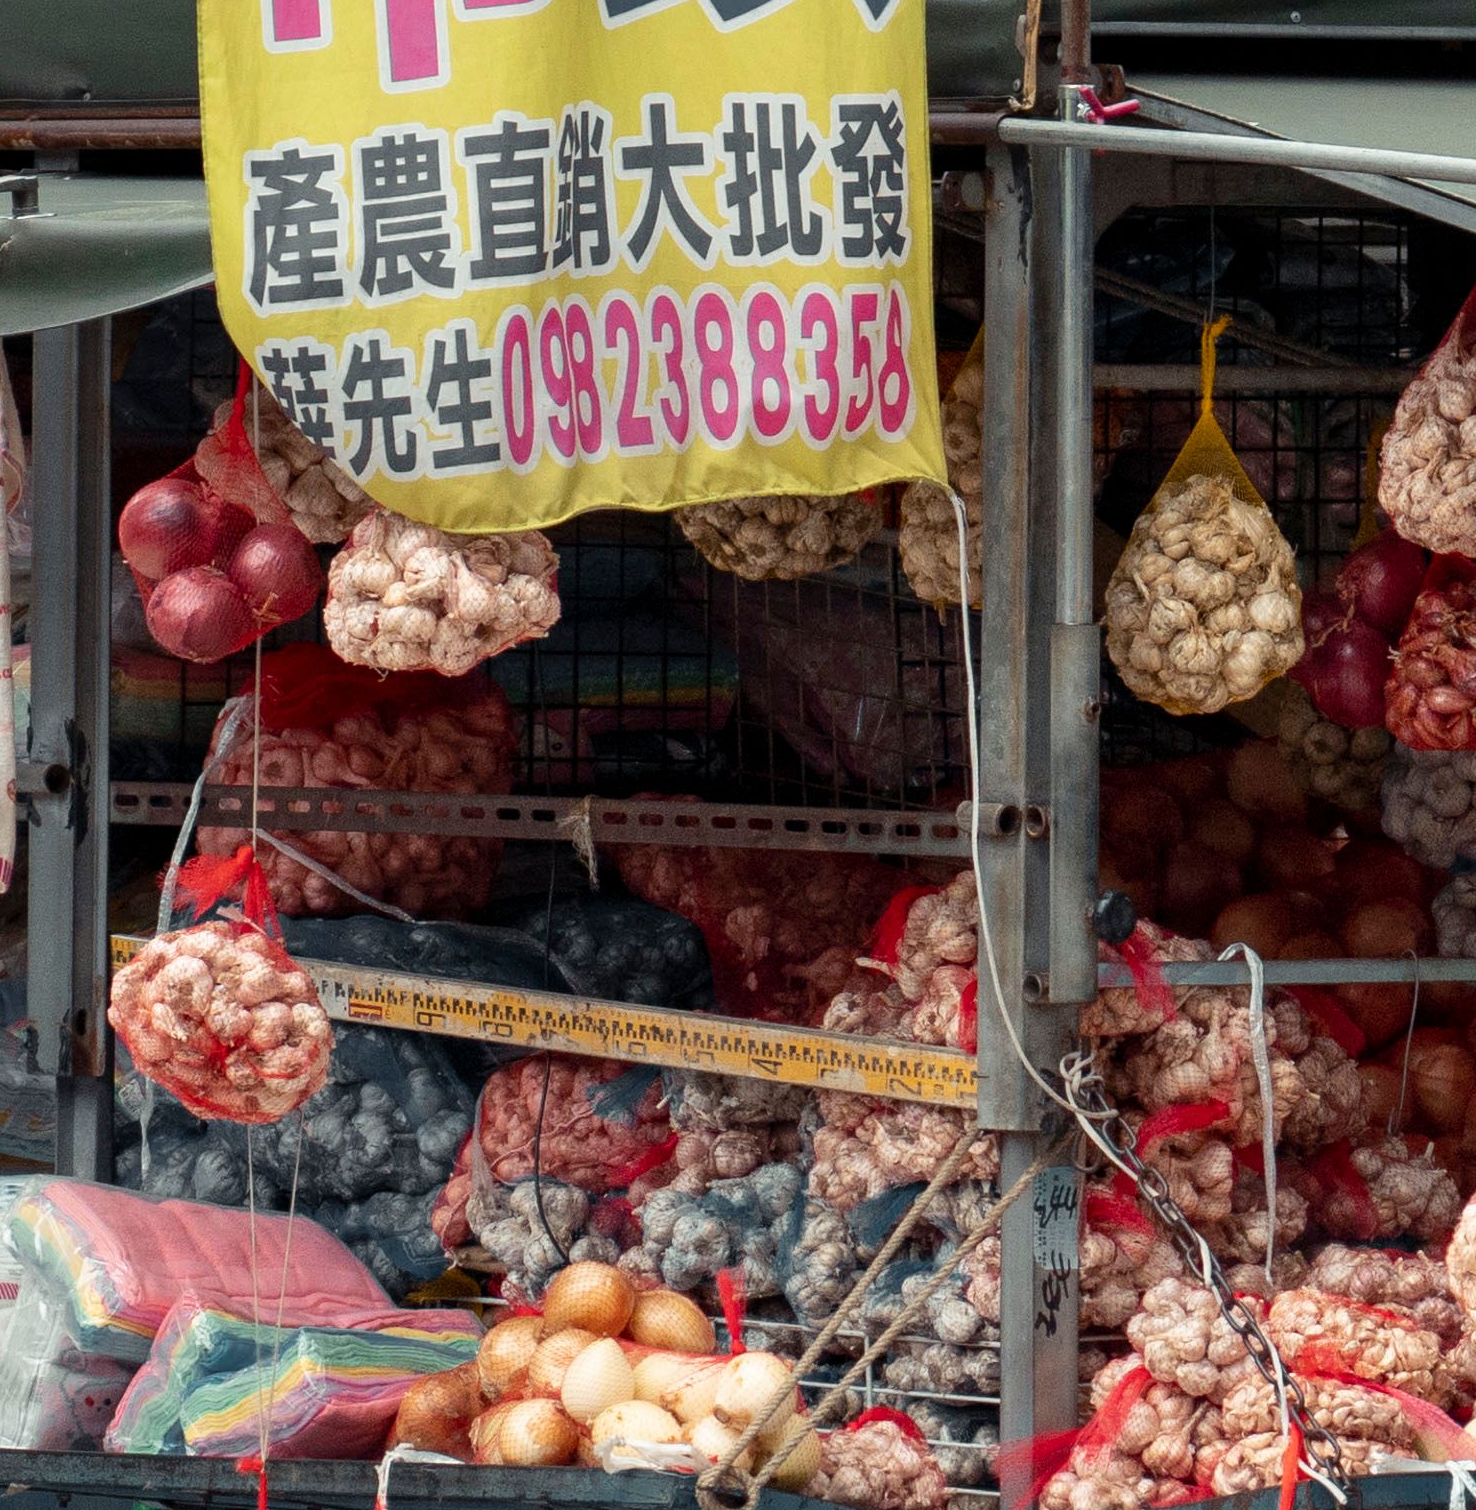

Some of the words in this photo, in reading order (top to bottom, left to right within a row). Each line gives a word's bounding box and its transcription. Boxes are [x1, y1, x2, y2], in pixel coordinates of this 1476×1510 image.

[246, 99, 907, 309] 產農直銷大批發
